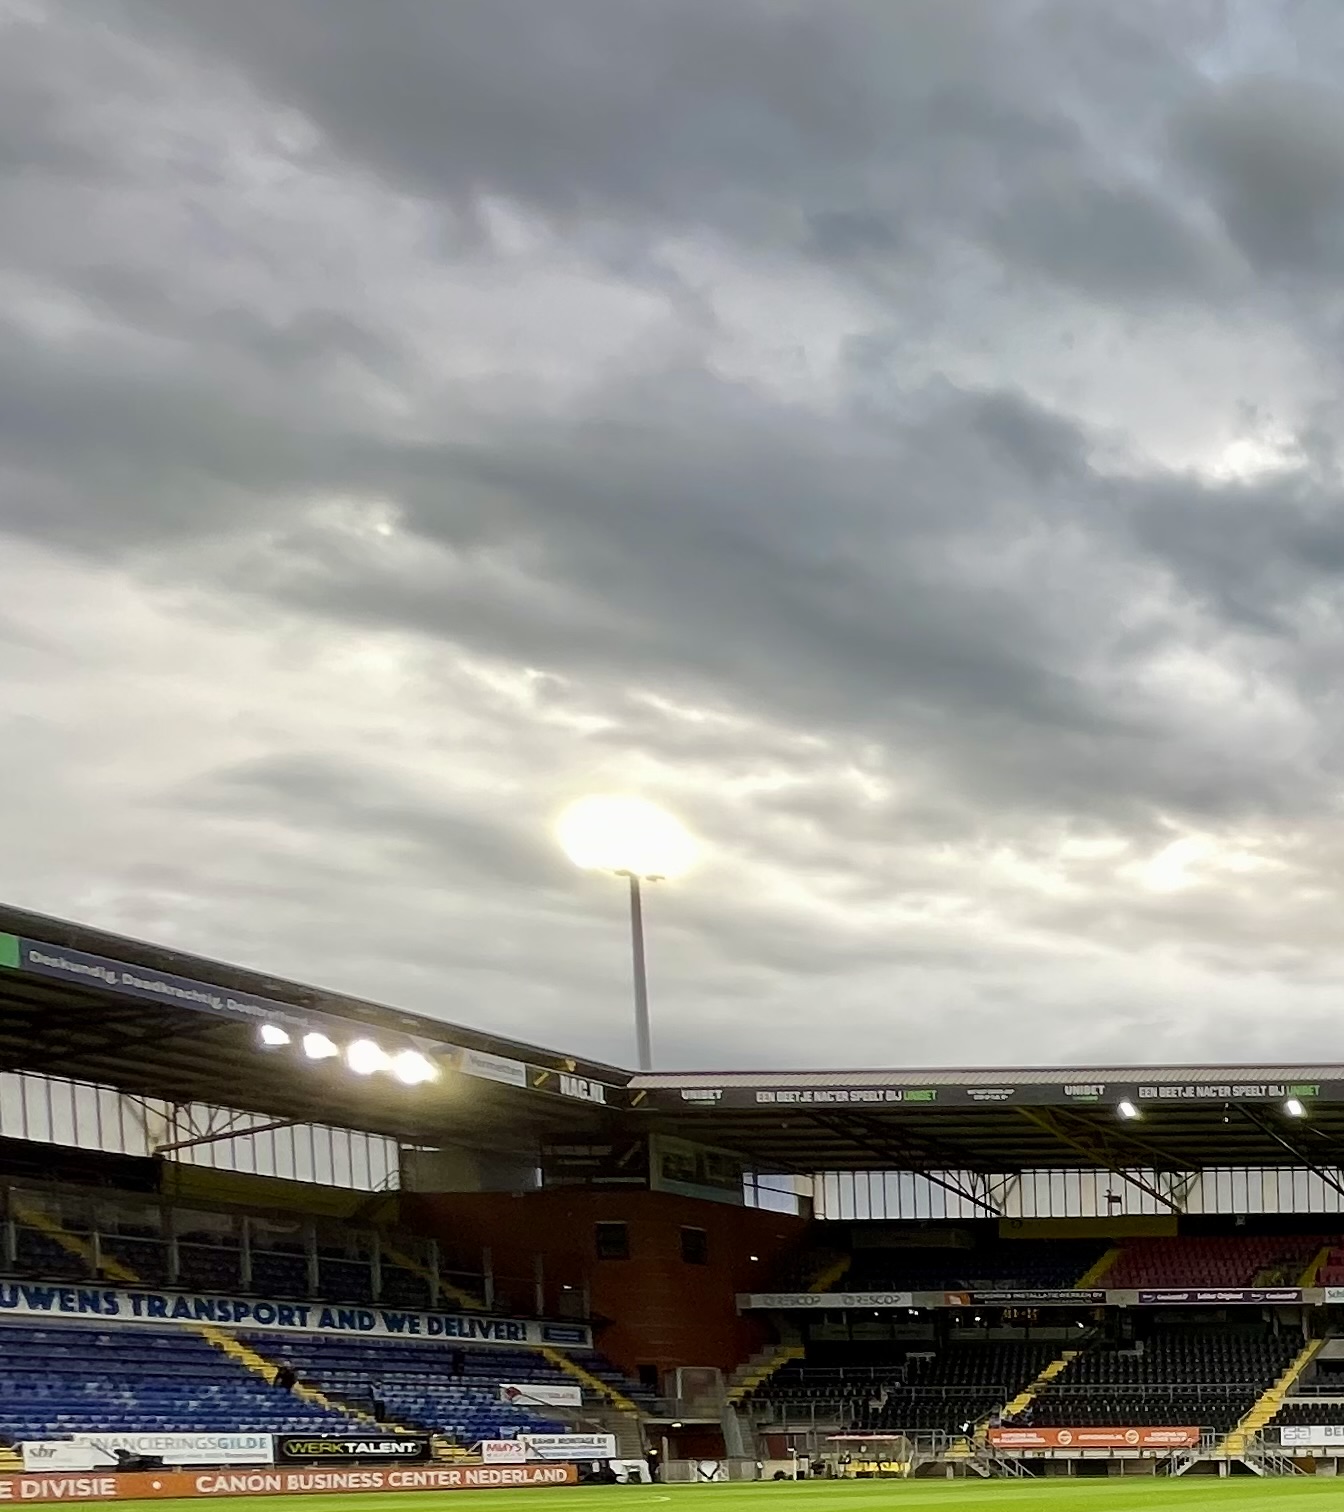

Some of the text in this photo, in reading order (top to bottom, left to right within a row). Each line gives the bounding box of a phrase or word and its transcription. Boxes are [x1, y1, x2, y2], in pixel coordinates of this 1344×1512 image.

[559, 1073, 608, 1105] NAC.NL
[681, 1088, 722, 1100] UNIBET
[756, 1089, 776, 1103] EEN
[850, 1089, 885, 1103] SPEELT
[886, 1089, 903, 1103] BIJ
[903, 1089, 938, 1103] UNIBET
[1064, 1085, 1105, 1097] UNIBET
[1139, 1085, 1158, 1098] EEN
[1232, 1085, 1267, 1098] SPEELT
[1269, 1085, 1285, 1098] BIJ
[1286, 1085, 1321, 1098] UNIBET
[128, 1292, 311, 1329] TRANSPORT
[319, 1308, 376, 1331] AND
[380, 1311, 420, 1334] WE
[427, 1315, 527, 1341] DELIVER!
[21, 1477, 118, 1499] DIVISIE
[196, 1467, 568, 1494] CANON BUSINESS CENTER NEDERLAND
